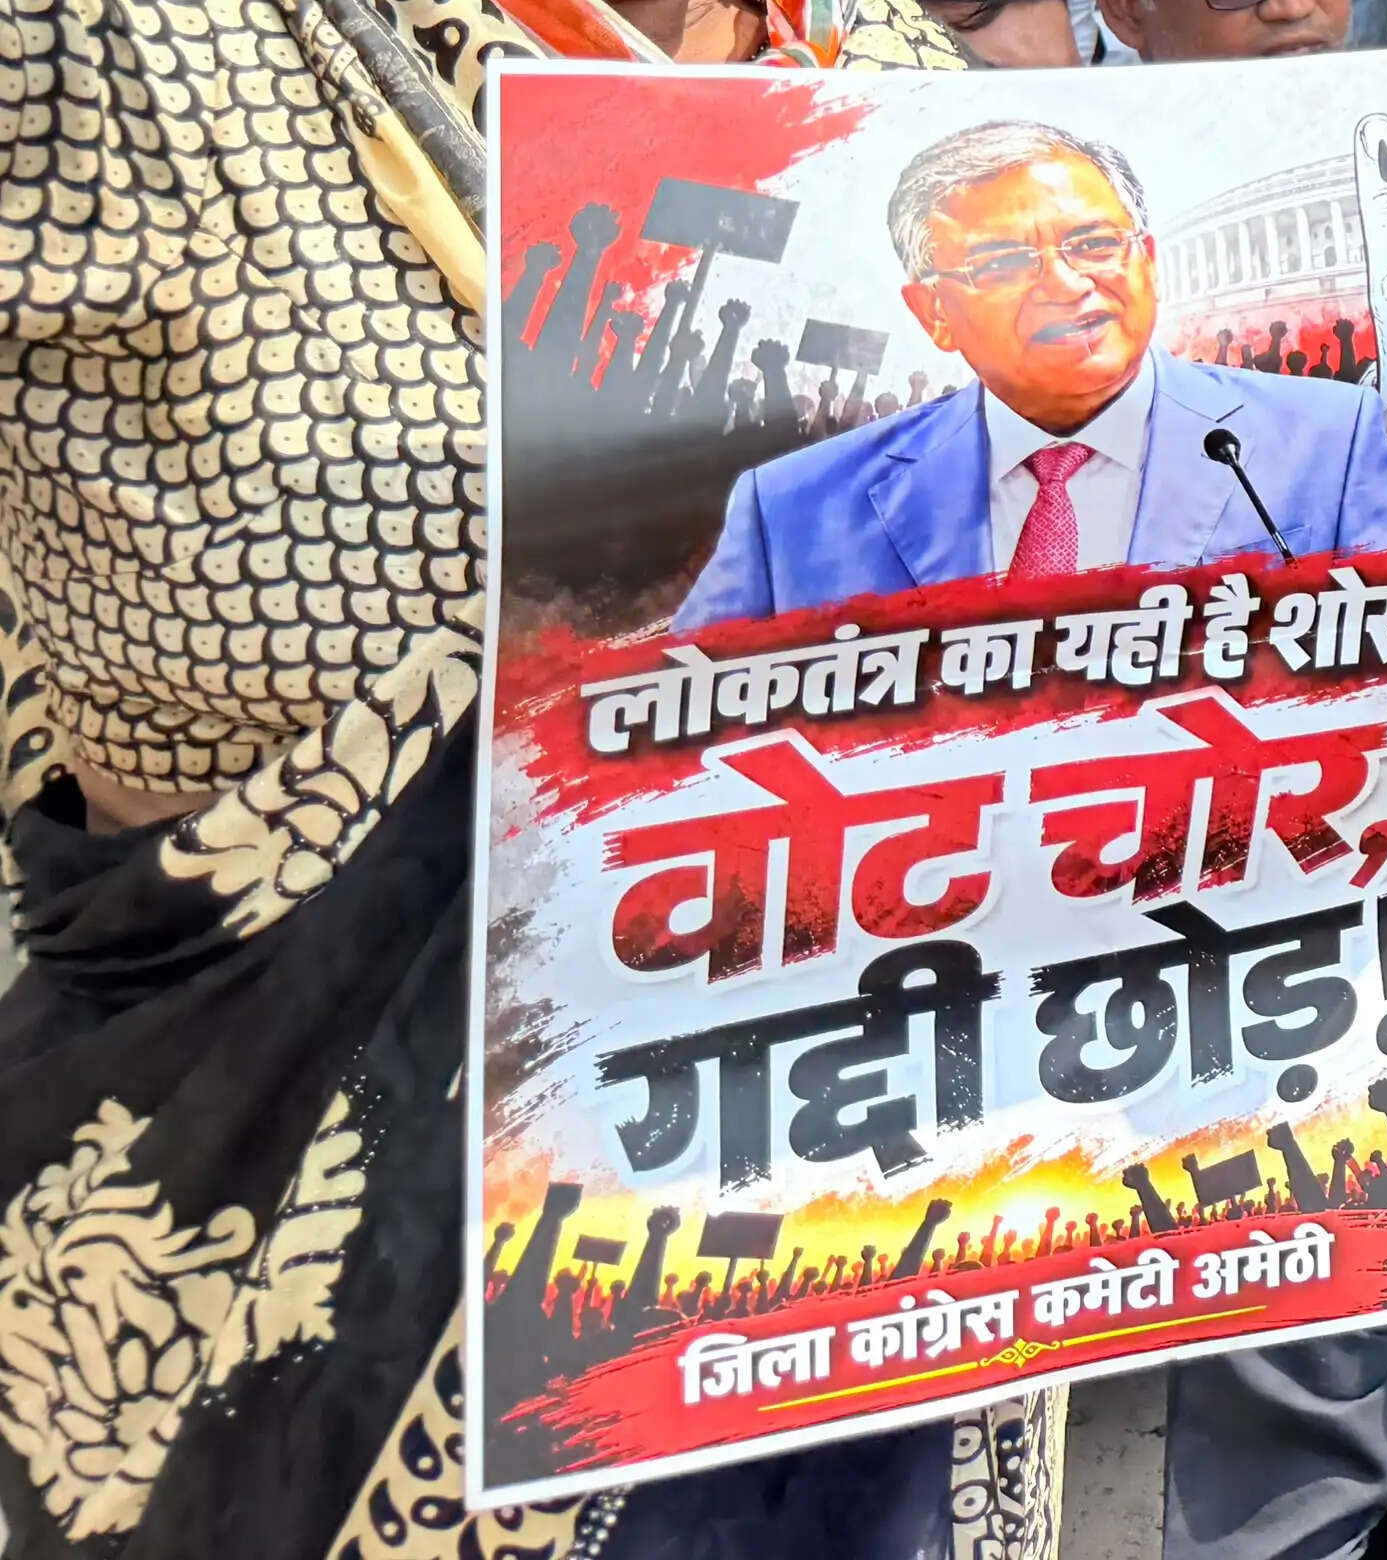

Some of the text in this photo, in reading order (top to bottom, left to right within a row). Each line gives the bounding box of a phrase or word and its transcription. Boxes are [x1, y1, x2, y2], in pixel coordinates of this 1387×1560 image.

[583, 622, 924, 755] लोकतंत्र
[940, 628, 1034, 697] का
[1056, 584, 1192, 686] यही
[1203, 573, 1258, 676] है
[601, 744, 1003, 985] वोट
[594, 939, 1003, 1192] गद्दी
[680, 1228, 1334, 1405] जिला कांग्रेस कमेटी अमेठी
